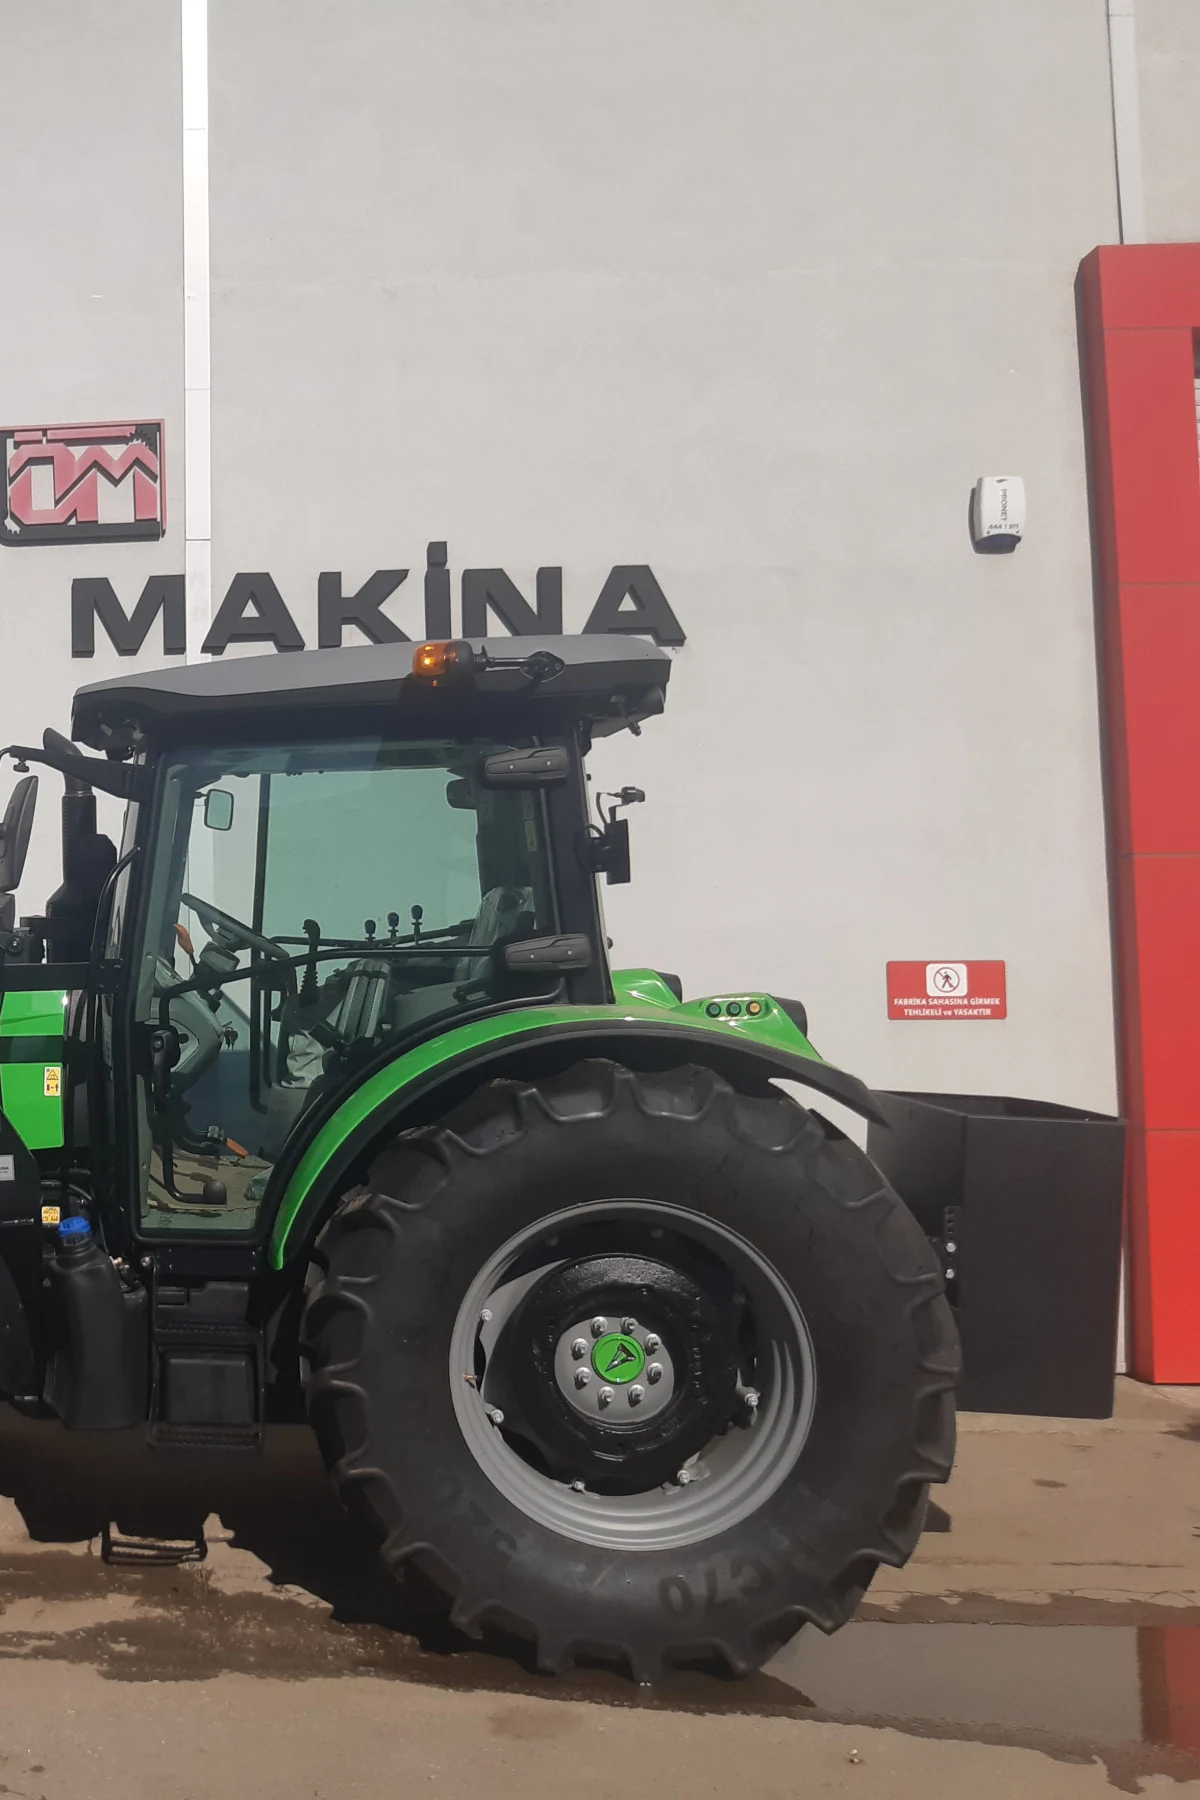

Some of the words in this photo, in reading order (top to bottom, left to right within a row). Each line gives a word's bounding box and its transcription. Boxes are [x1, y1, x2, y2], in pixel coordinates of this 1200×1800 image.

[1000, 488, 1008, 522] PRONET
[71, 541, 687, 659] MAKİNA
[893, 997, 927, 1006] FABRİKA
[928, 997, 969, 1006] SAHASINA
[970, 996, 1001, 1006] GİRMEK
[903, 1007, 942, 1016] TEHLİKELİ
[953, 1008, 992, 1016] YASAKTIR
